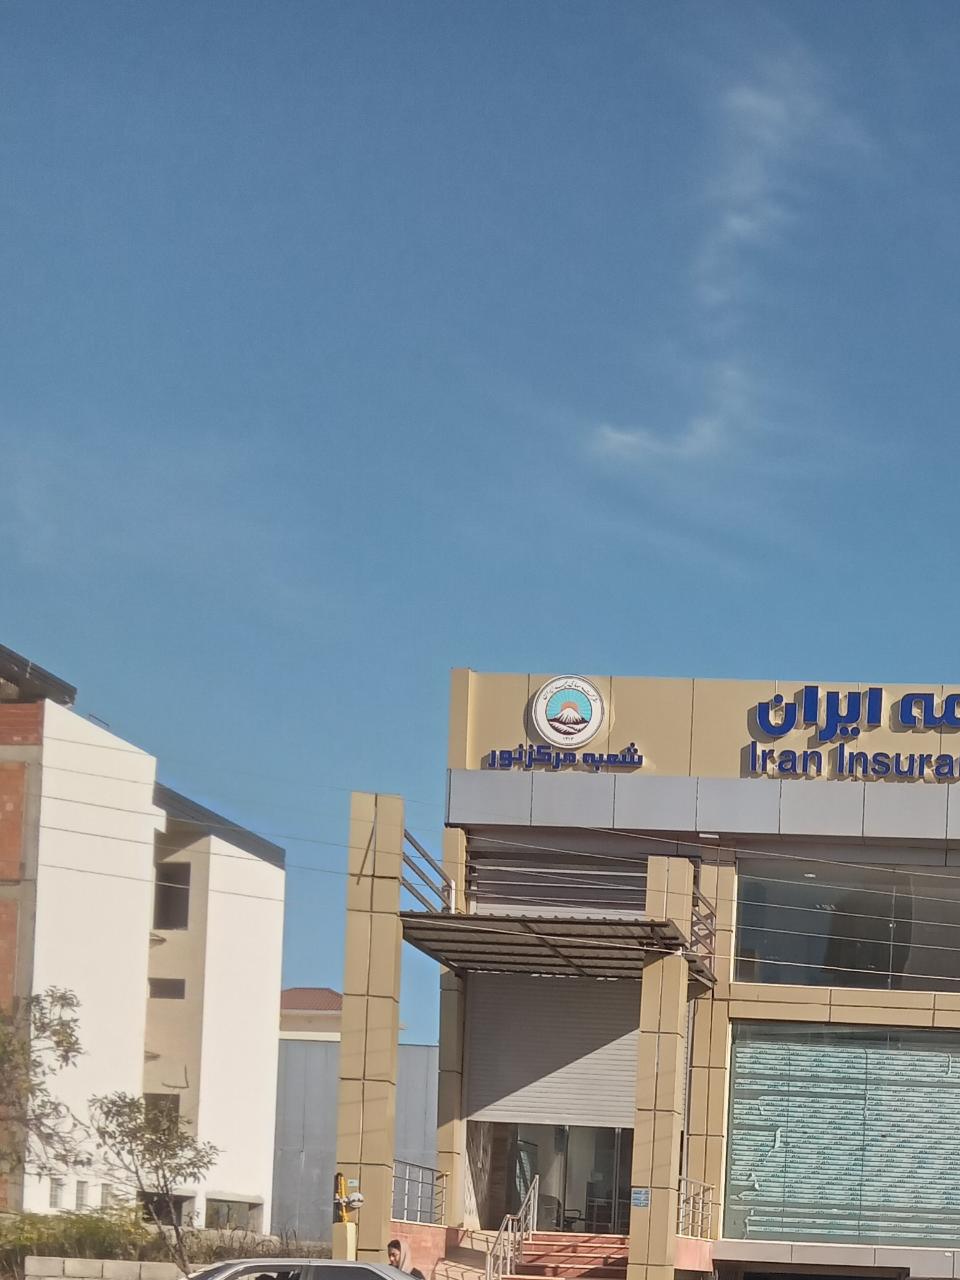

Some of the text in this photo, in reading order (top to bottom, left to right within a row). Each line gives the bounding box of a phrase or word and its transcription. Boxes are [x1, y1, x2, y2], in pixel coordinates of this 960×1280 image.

[757, 685, 883, 742] ایران
[583, 742, 644, 771] شعبه
[751, 741, 823, 775] Iran
